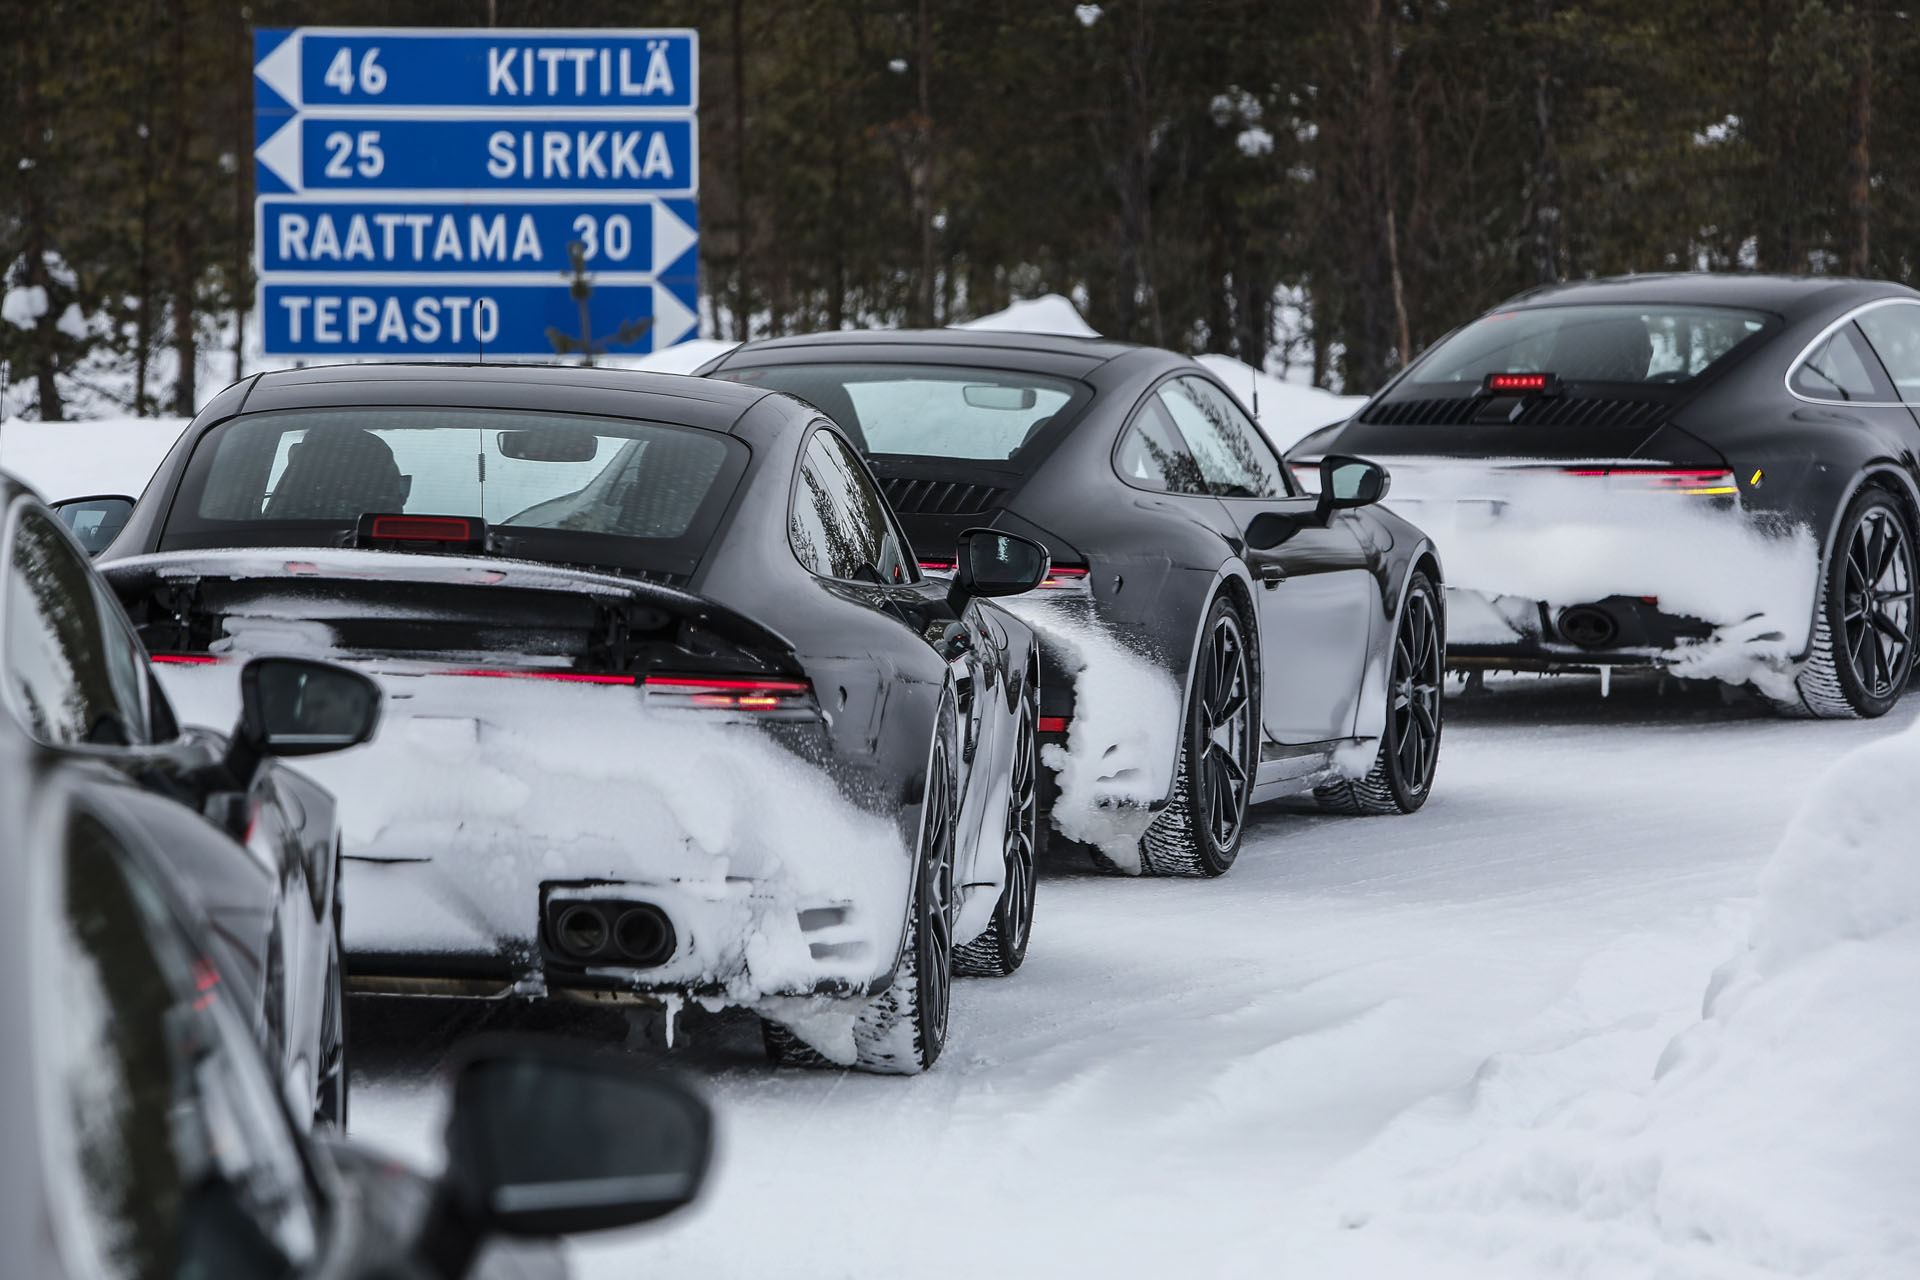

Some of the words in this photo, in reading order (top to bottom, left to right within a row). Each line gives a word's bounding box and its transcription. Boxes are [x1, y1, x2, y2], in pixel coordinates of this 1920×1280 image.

[325, 47, 387, 94] 46
[488, 40, 674, 95] KITTILÄ
[325, 131, 385, 178] 25
[487, 131, 674, 179] SIRKKA
[279, 214, 543, 261] RAATTAMA
[572, 213, 632, 262] 30
[280, 297, 499, 343] TEPASTO
